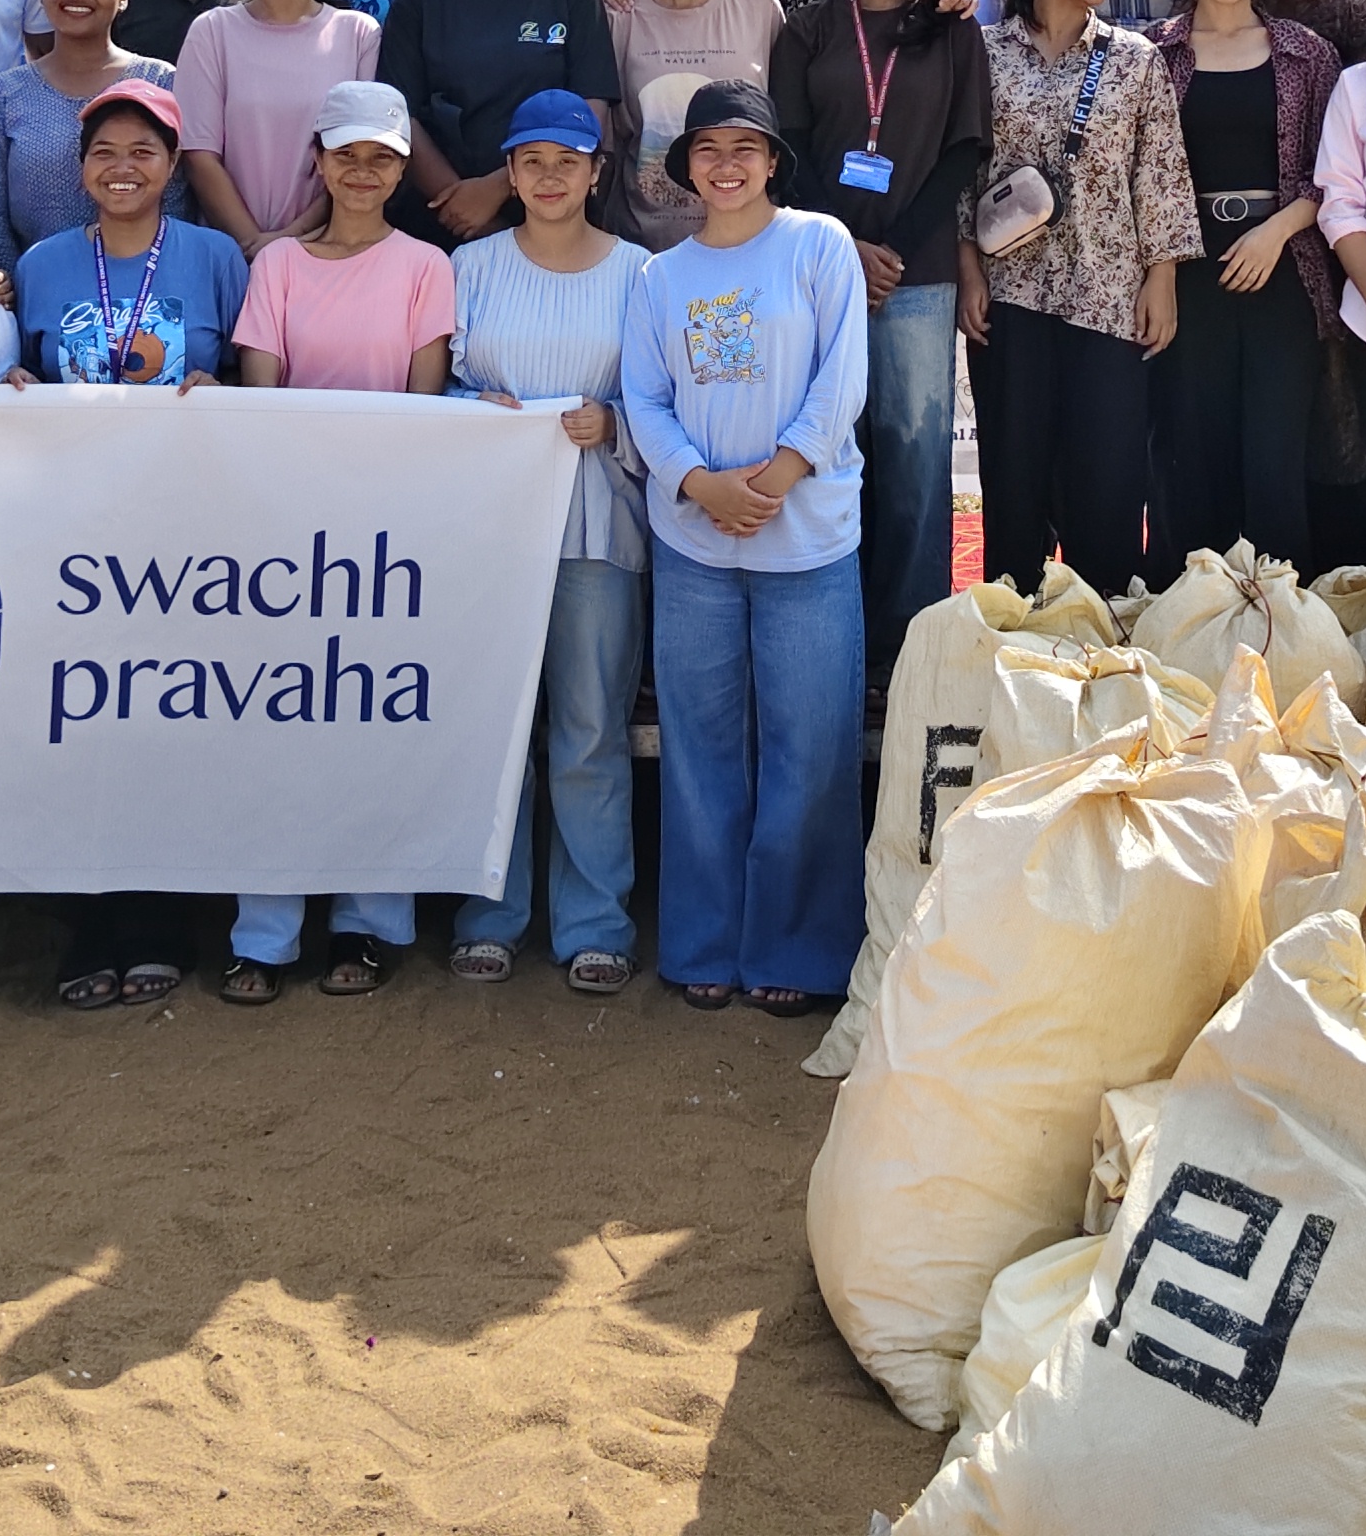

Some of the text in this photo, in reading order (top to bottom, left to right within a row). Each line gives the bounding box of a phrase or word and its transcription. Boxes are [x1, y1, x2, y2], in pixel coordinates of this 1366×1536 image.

[1079, 48, 1105, 100] YOUNG
[57, 531, 421, 617] swachh
[49, 635, 430, 743] pravaha
